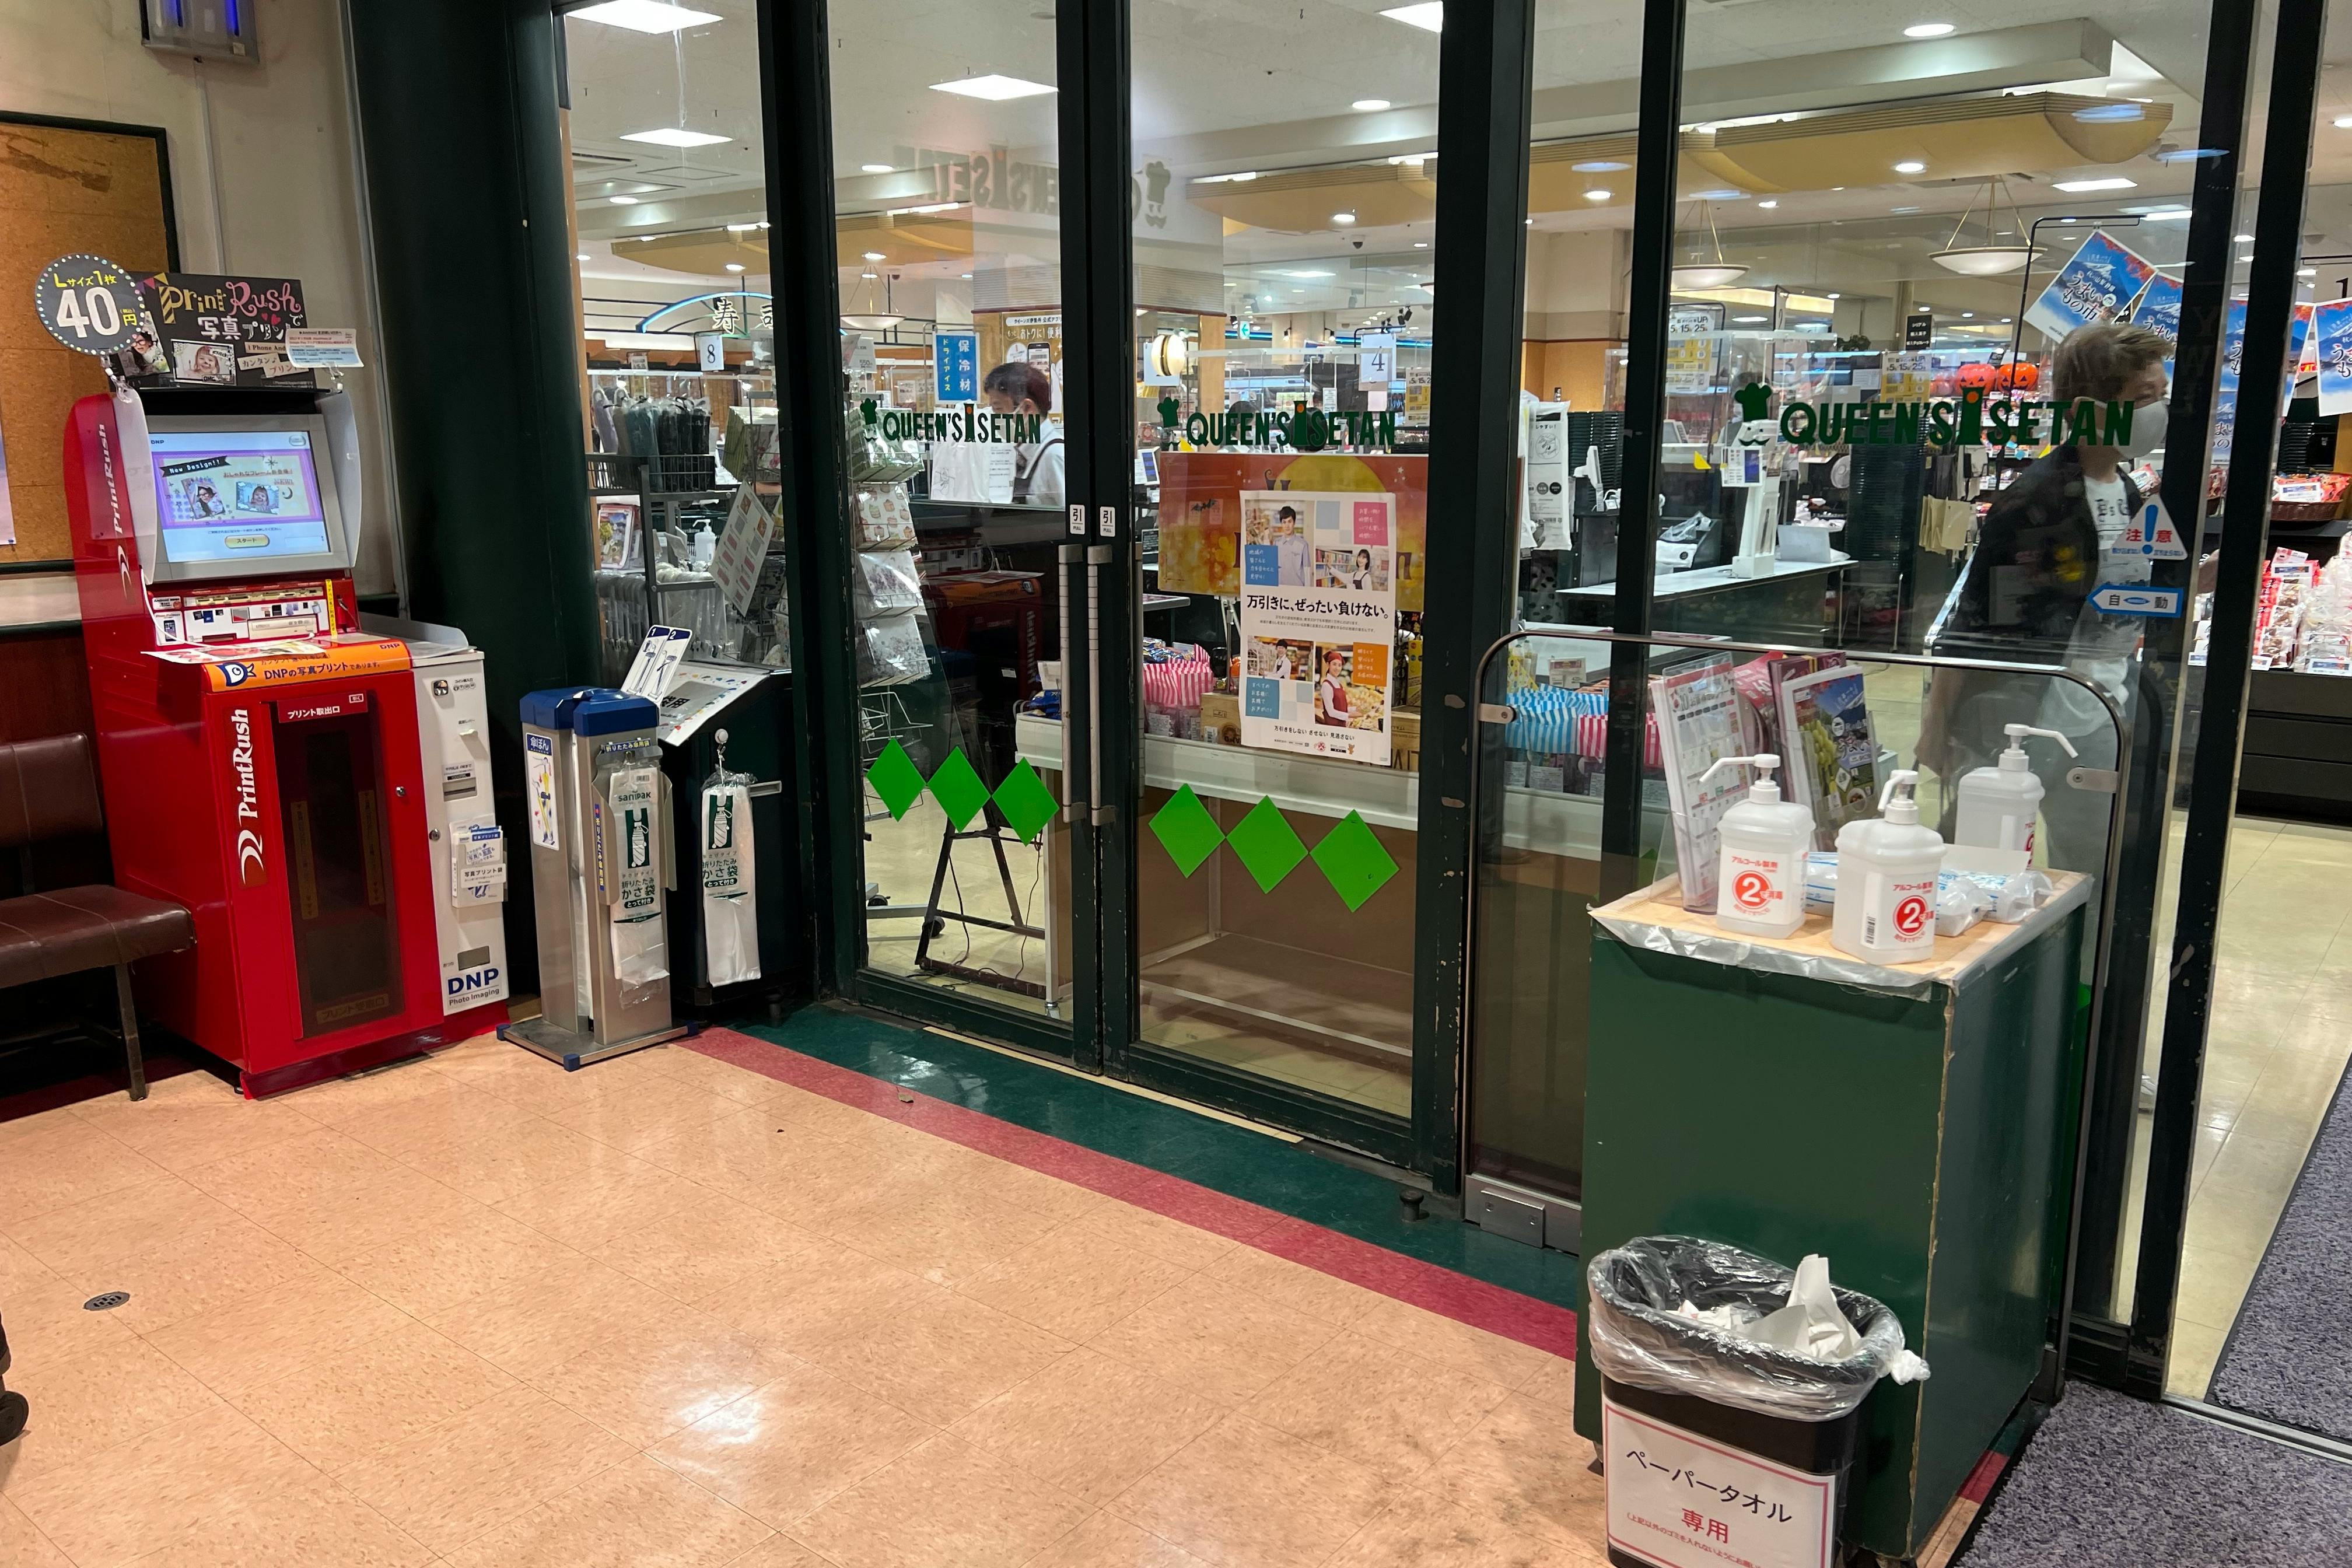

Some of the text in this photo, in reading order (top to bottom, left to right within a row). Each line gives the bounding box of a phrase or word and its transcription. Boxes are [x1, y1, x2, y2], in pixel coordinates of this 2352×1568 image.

[197, 315, 291, 341] 写真プリン
[707, 344, 716, 364] 8
[942, 338, 952, 392] ドライアイス
[958, 339, 971, 392] 保冷材
[1371, 345, 1385, 372] 4
[269, 363, 293, 374] プリン
[883, 412, 963, 442] QUEEN'S
[1185, 411, 1290, 447] QUEEN'S
[1780, 401, 1954, 446] QUEEN'S
[1073, 508, 1082, 522] 引
[1103, 510, 1112, 524] 引
[1247, 594, 1389, 620] 万引きに、ぜったい負けない。
[650, 628, 657, 636] 1
[669, 631, 677, 640] 2
[1274, 725, 1307, 734] 万引きをしない
[231, 708, 258, 825] PrintRush
[621, 885, 655, 900] かさ袋
[1741, 877, 1761, 903] 2
[1902, 902, 1921, 929] 2
[447, 968, 499, 995] DNP
[449, 988, 500, 1006] Photo Imaging
[1626, 1448, 1793, 1524] ペーパータオル
[1681, 1507, 1730, 1545] 専用
